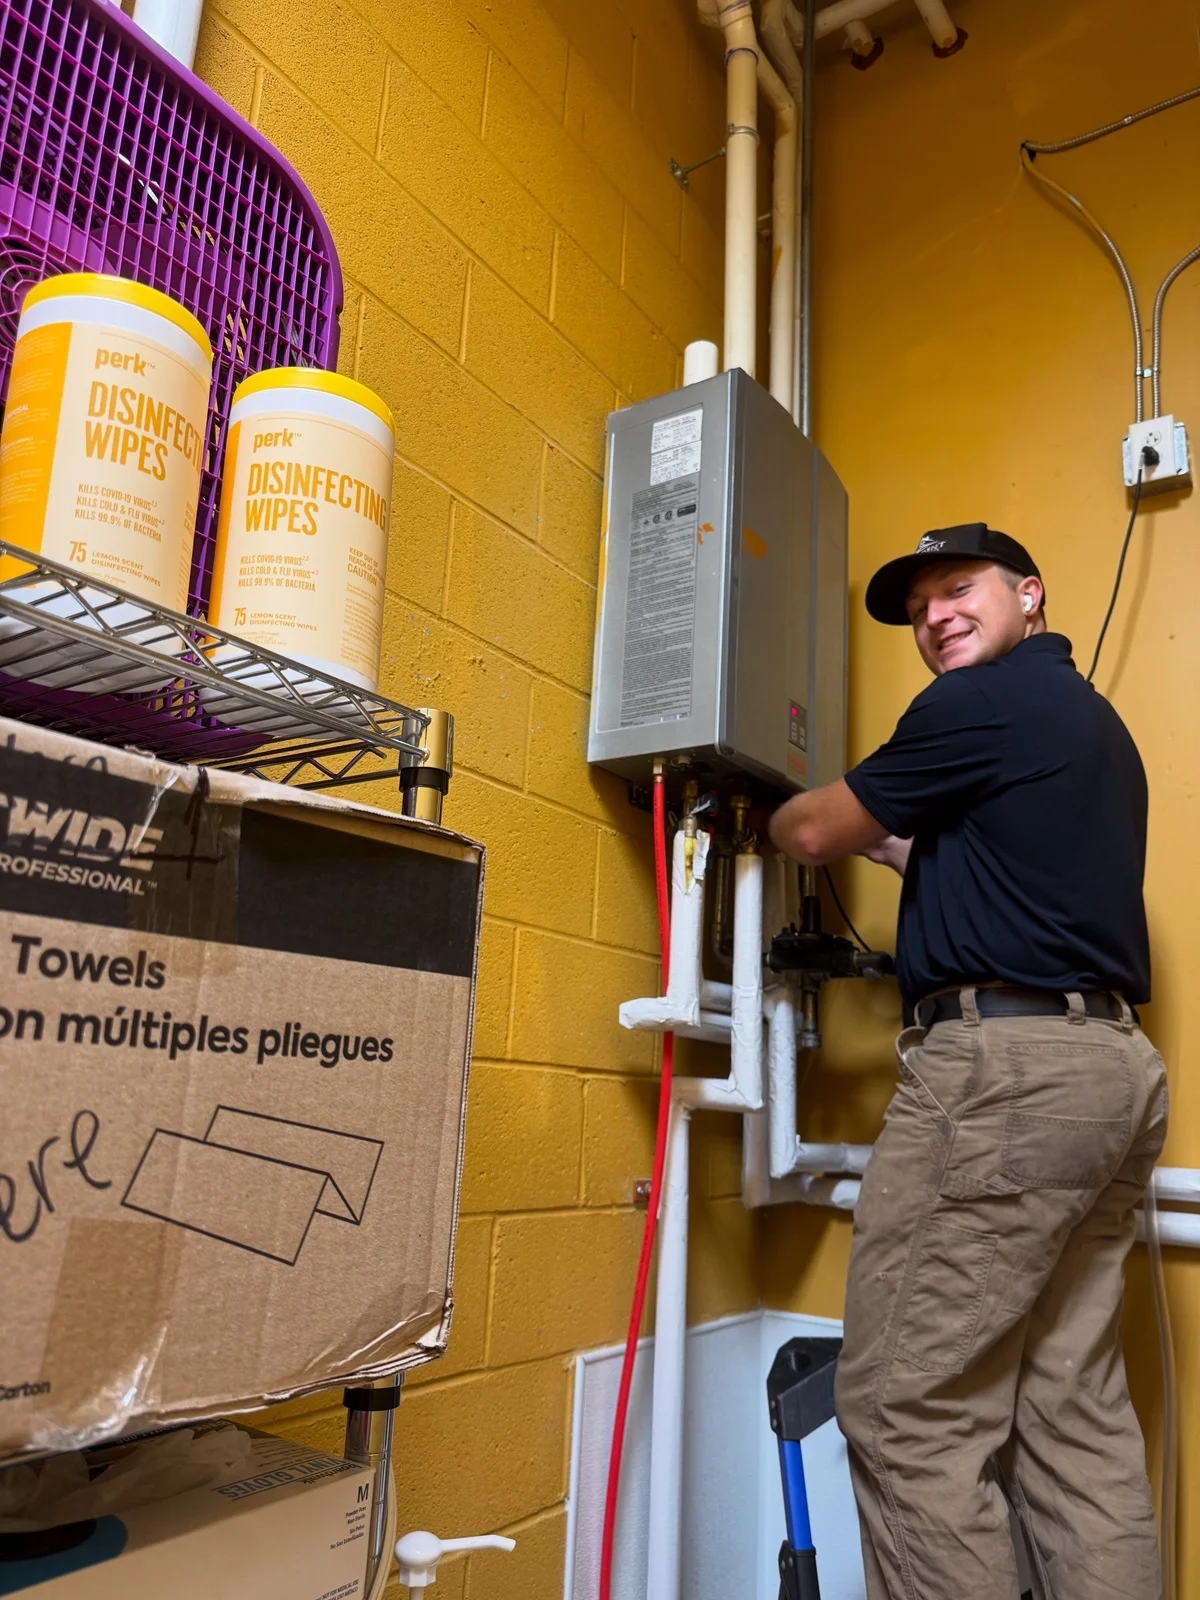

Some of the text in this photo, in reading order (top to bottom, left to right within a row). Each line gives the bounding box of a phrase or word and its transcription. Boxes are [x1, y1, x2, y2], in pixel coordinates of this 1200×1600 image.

[85, 420, 168, 481] WIPES
[78, 483, 99, 495] KILLS
[101, 488, 132, 503] COVID-19
[247, 461, 387, 534] DISINFECTING
[76, 495, 97, 508] KILLS
[99, 501, 119, 512] COLD
[120, 505, 126, 515] &
[128, 508, 140, 519] FLU
[245, 498, 319, 536] WIPES
[74, 508, 162, 542] KILLS 99.9% OF BACTERIA
[69, 540, 87, 563] 75
[92, 551, 144, 570] LEMON SCENT
[240, 555, 255, 565] KILLS
[257, 554, 282, 565] COVID-19
[91, 558, 161, 587] DISINFECTING WIPES
[239, 566, 254, 577] KILLS
[256, 566, 271, 575] COLD
[273, 566, 277, 575] &
[280, 567, 291, 576] FLU
[347, 563, 377, 587] CAUTION
[238, 577, 316, 592] KILLS 99.9% OF BACTERIA
[234, 607, 247, 627] 75
[249, 619, 317, 631] DISINFECTING WIPES
[11, 933, 167, 989] Towels
[57, 1005, 250, 1061] múltiples
[257, 1022, 394, 1069] pliegues
[218, 1456, 347, 1499] VINYL GLOVES
[357, 1483, 369, 1504] M
